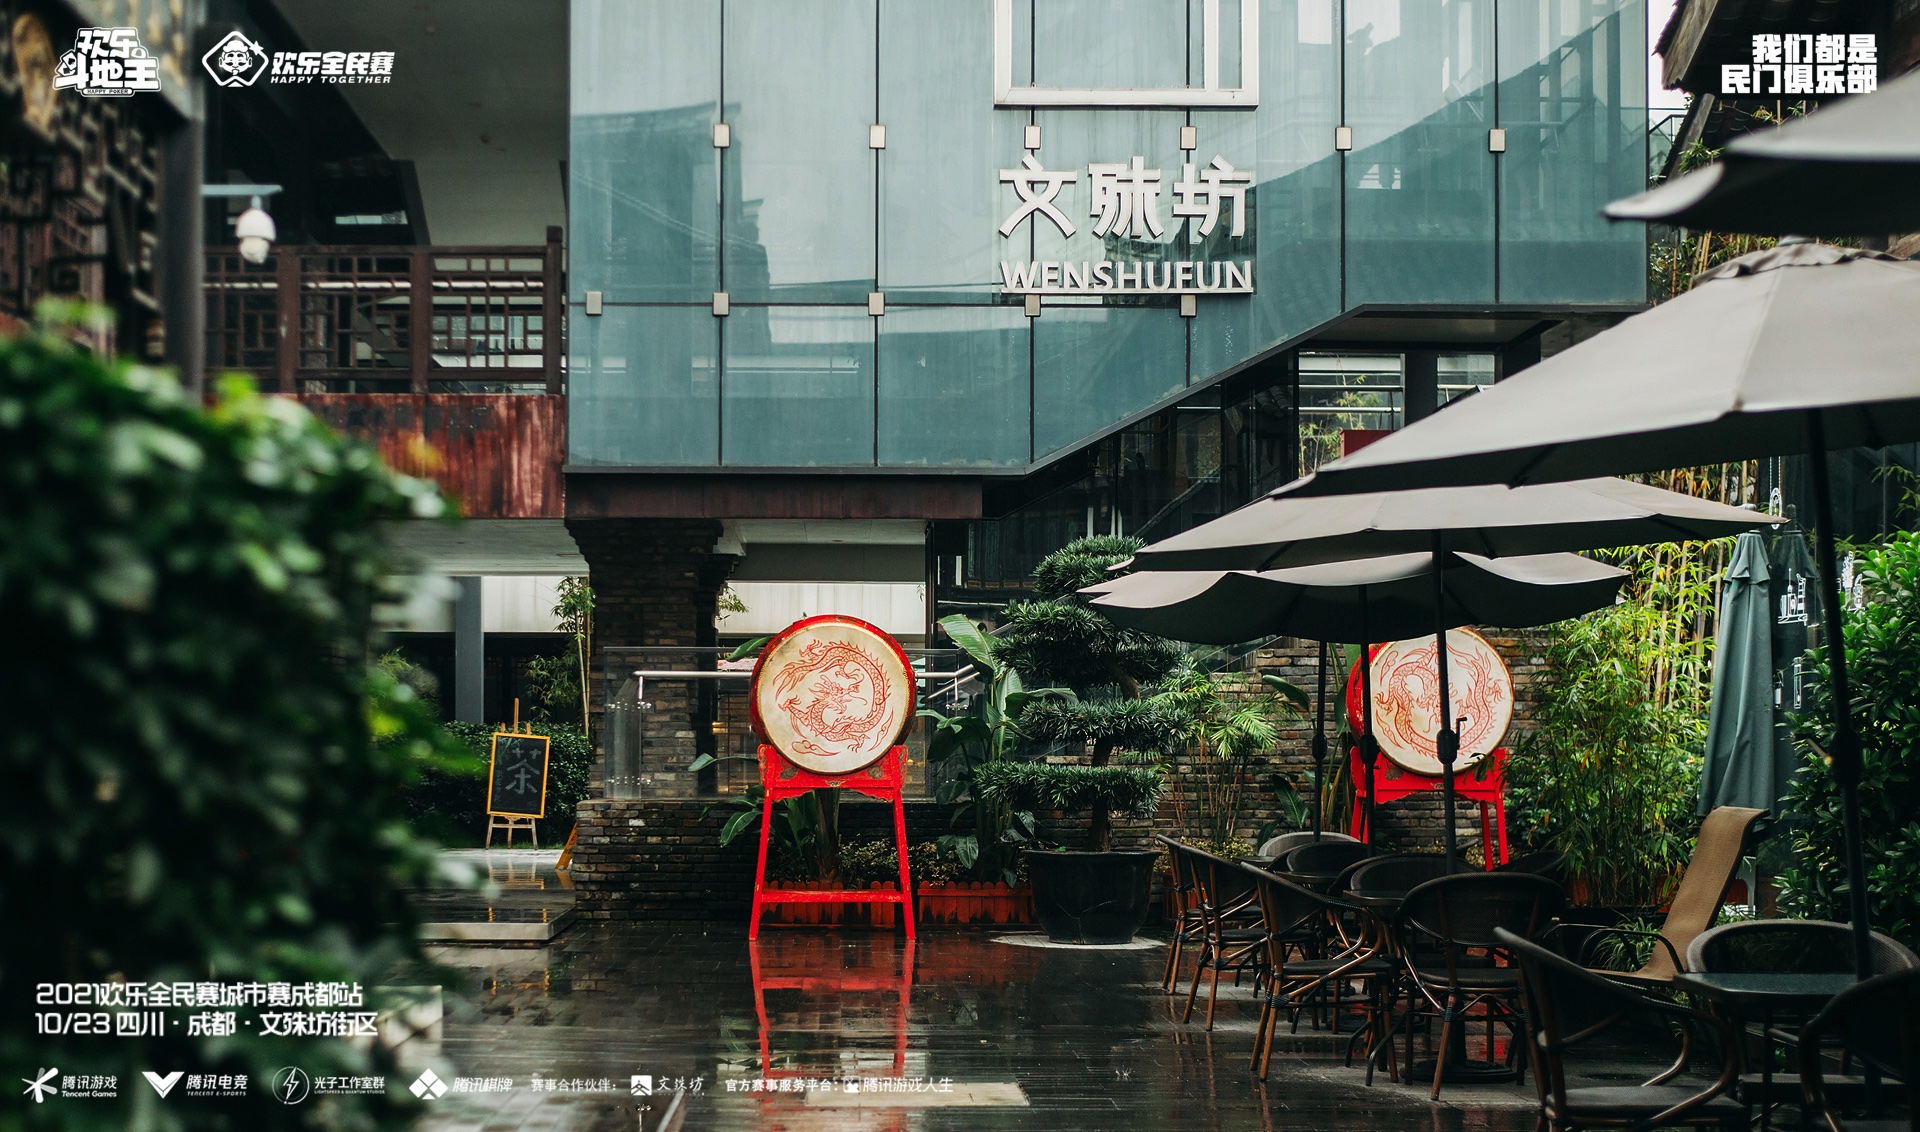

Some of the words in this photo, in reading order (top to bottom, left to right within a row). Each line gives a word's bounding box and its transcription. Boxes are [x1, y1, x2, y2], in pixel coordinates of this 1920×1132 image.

[999, 154, 1252, 239] 文殊坊
[1000, 260, 1251, 290] WENSHUFUN
[505, 748, 542, 794] 茶
